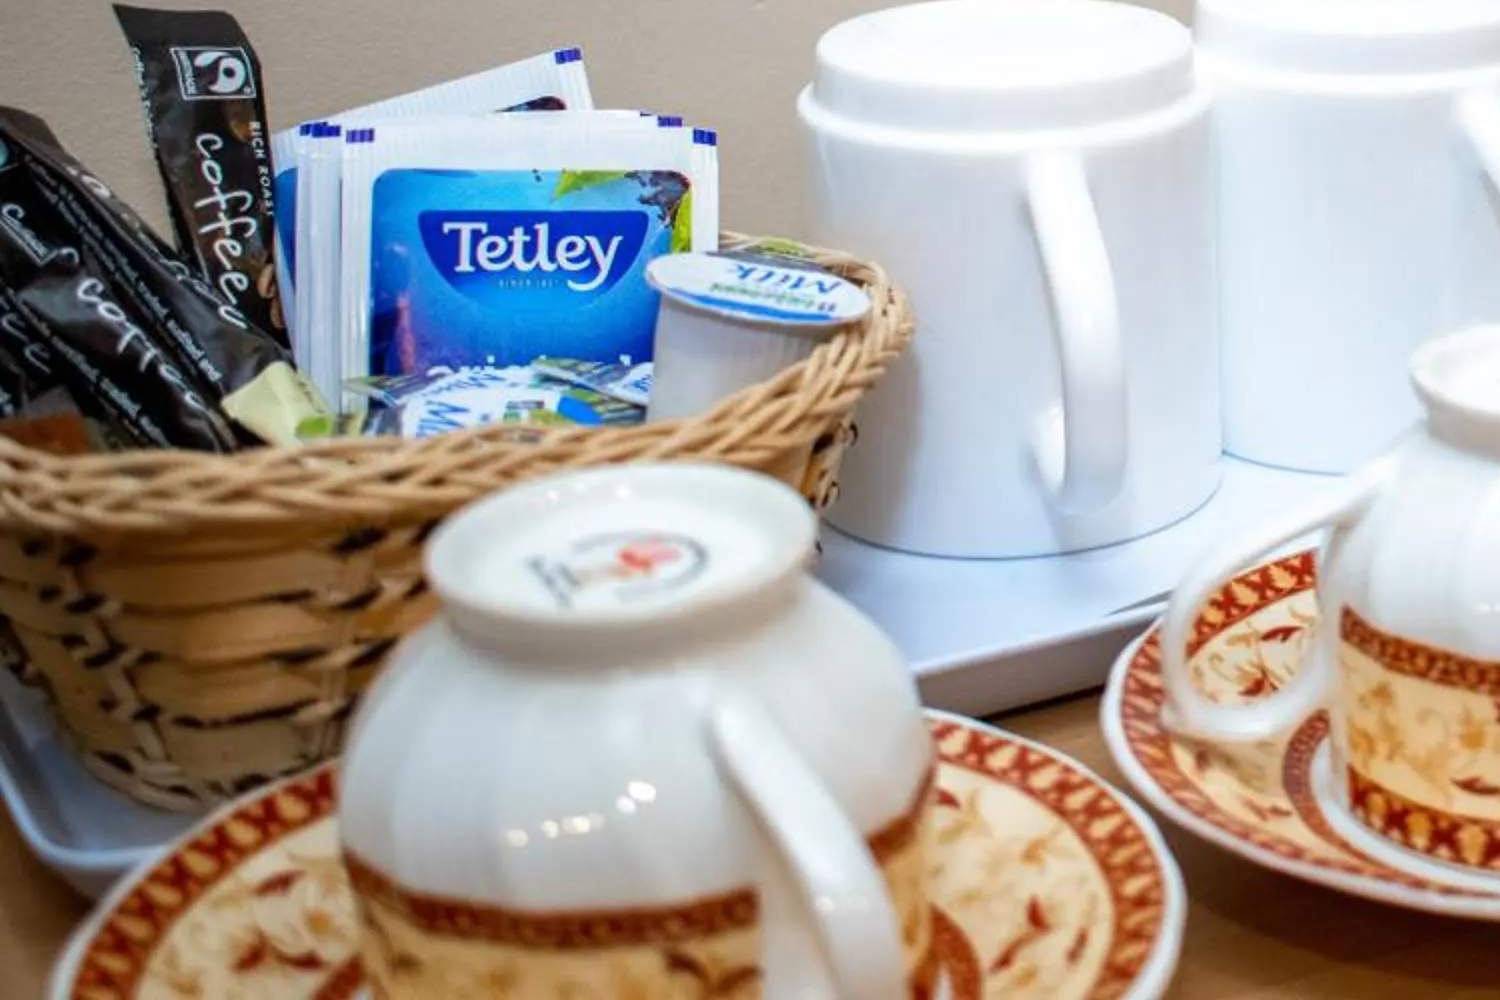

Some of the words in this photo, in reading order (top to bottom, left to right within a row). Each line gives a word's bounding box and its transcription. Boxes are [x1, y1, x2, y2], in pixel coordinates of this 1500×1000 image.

[250, 121, 266, 159] RICH
[194, 133, 257, 307] coffee
[257, 164, 276, 218] ROAST
[443, 221, 623, 292] Tetley
